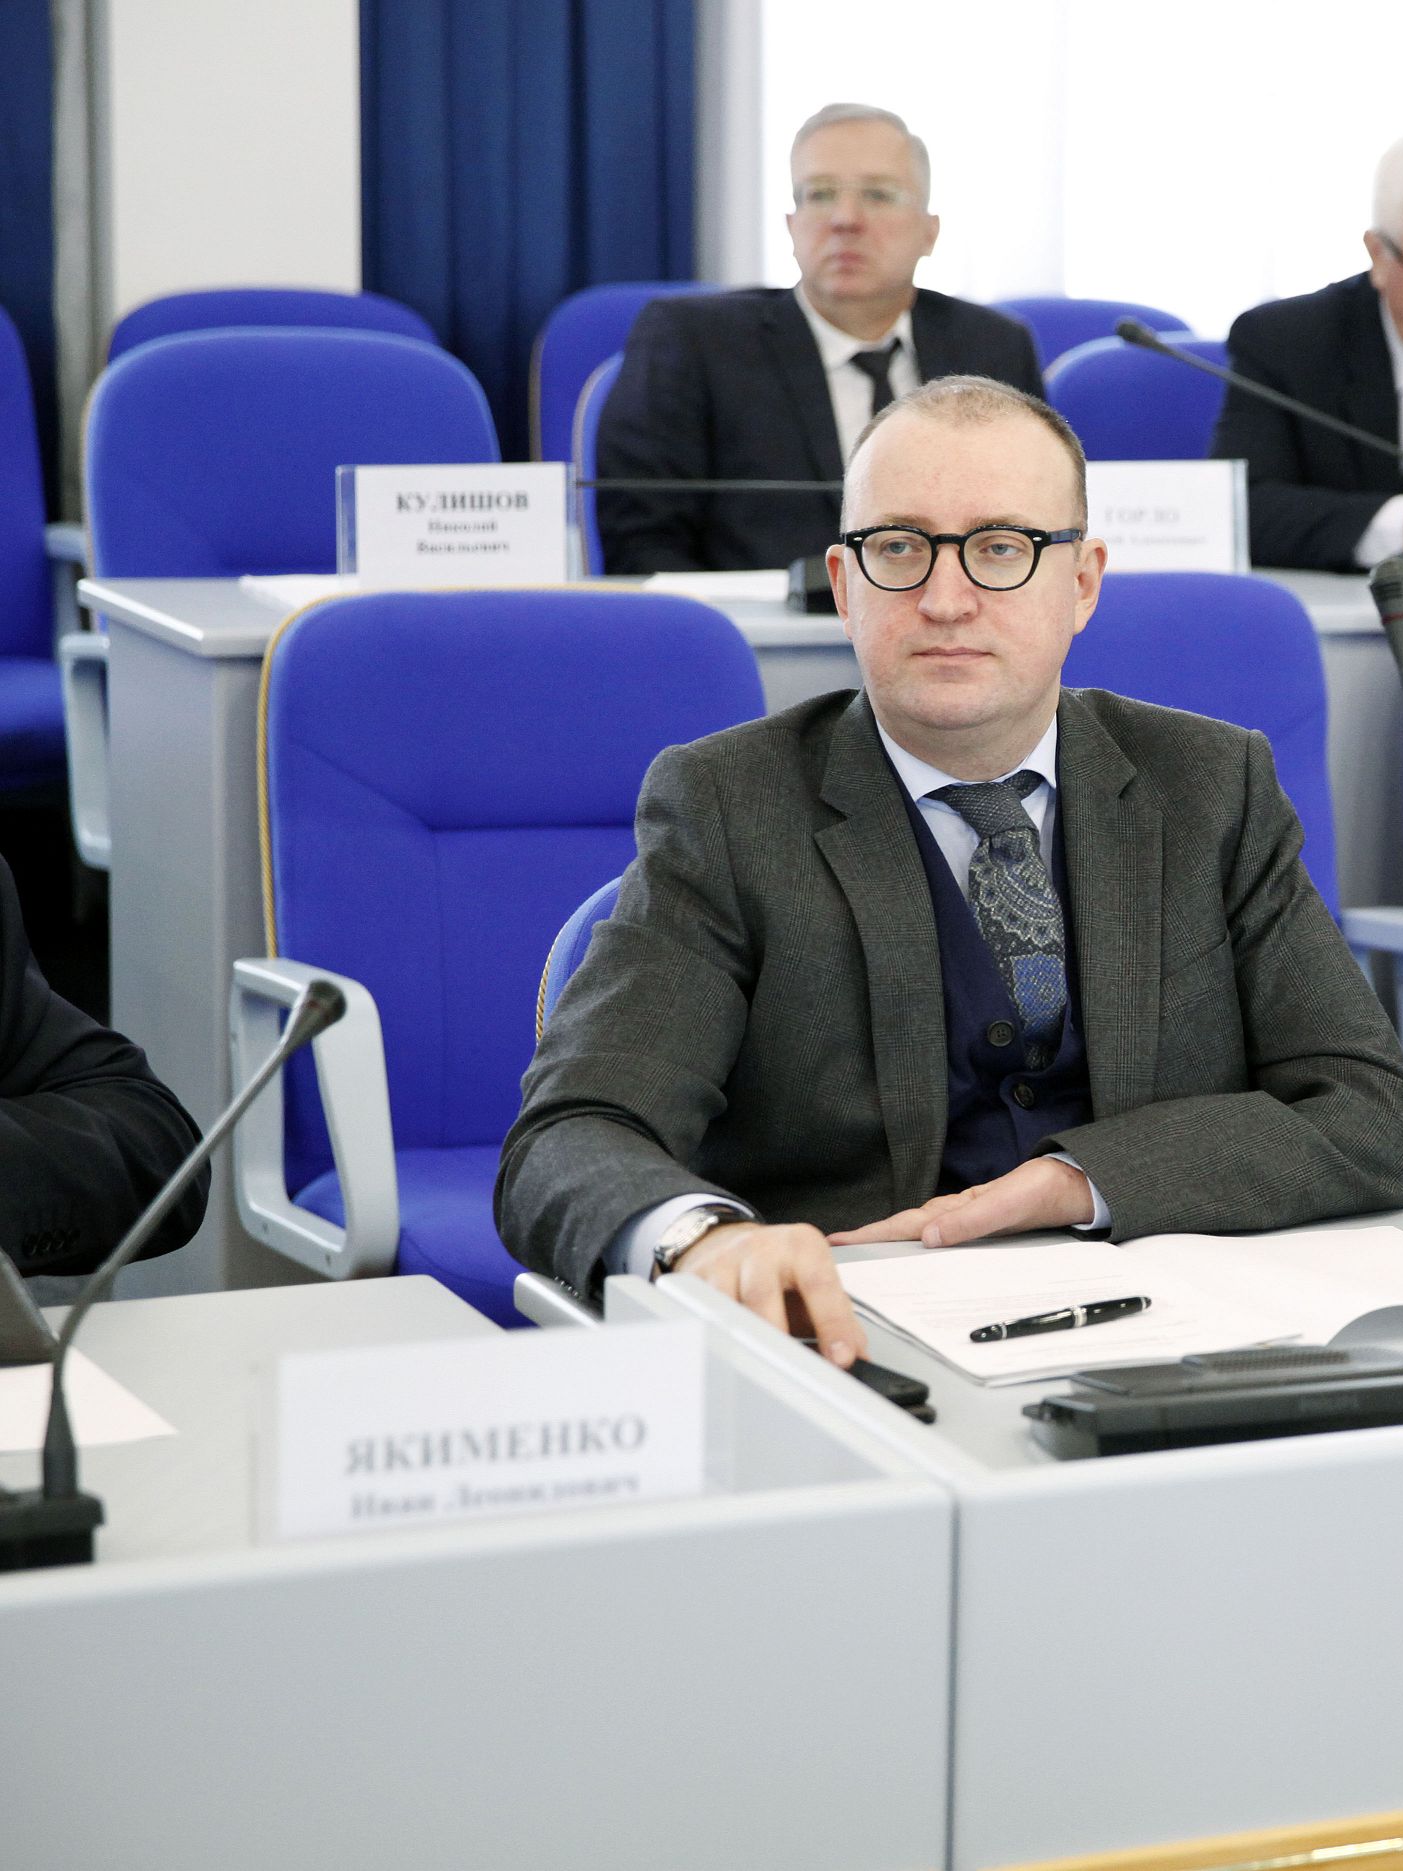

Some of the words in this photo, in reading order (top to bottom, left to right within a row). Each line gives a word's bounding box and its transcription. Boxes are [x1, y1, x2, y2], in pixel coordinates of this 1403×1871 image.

[395, 491, 529, 511] КУЛИШОВ
[345, 1415, 648, 1476] ЯКИМЕНКО
[351, 1491, 435, 1521] Иван
